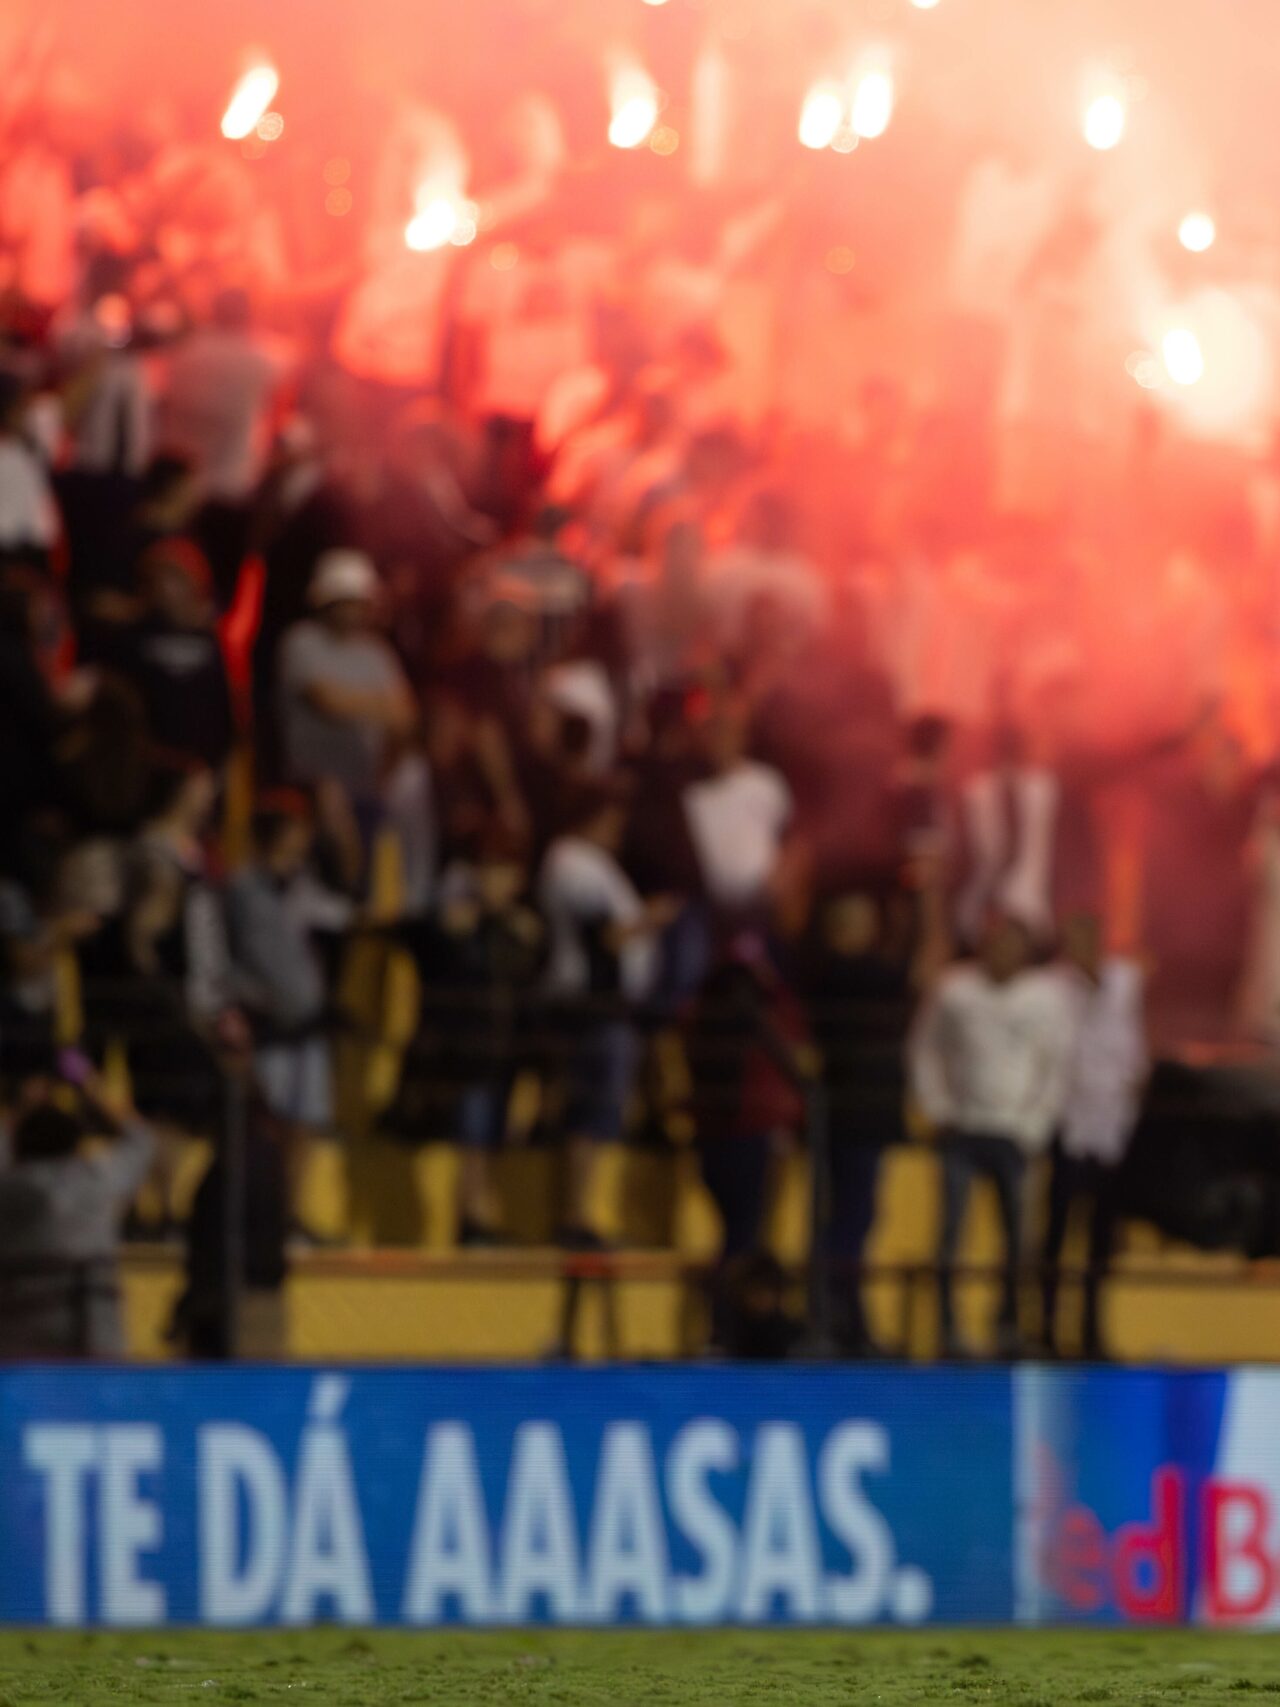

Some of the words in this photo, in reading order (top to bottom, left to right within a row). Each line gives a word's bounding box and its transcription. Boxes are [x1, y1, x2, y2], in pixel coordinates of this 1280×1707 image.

[23, 1421, 166, 1626] TE
[198, 1372, 376, 1626] DÁ
[404, 1417, 934, 1626] AAASAS.
